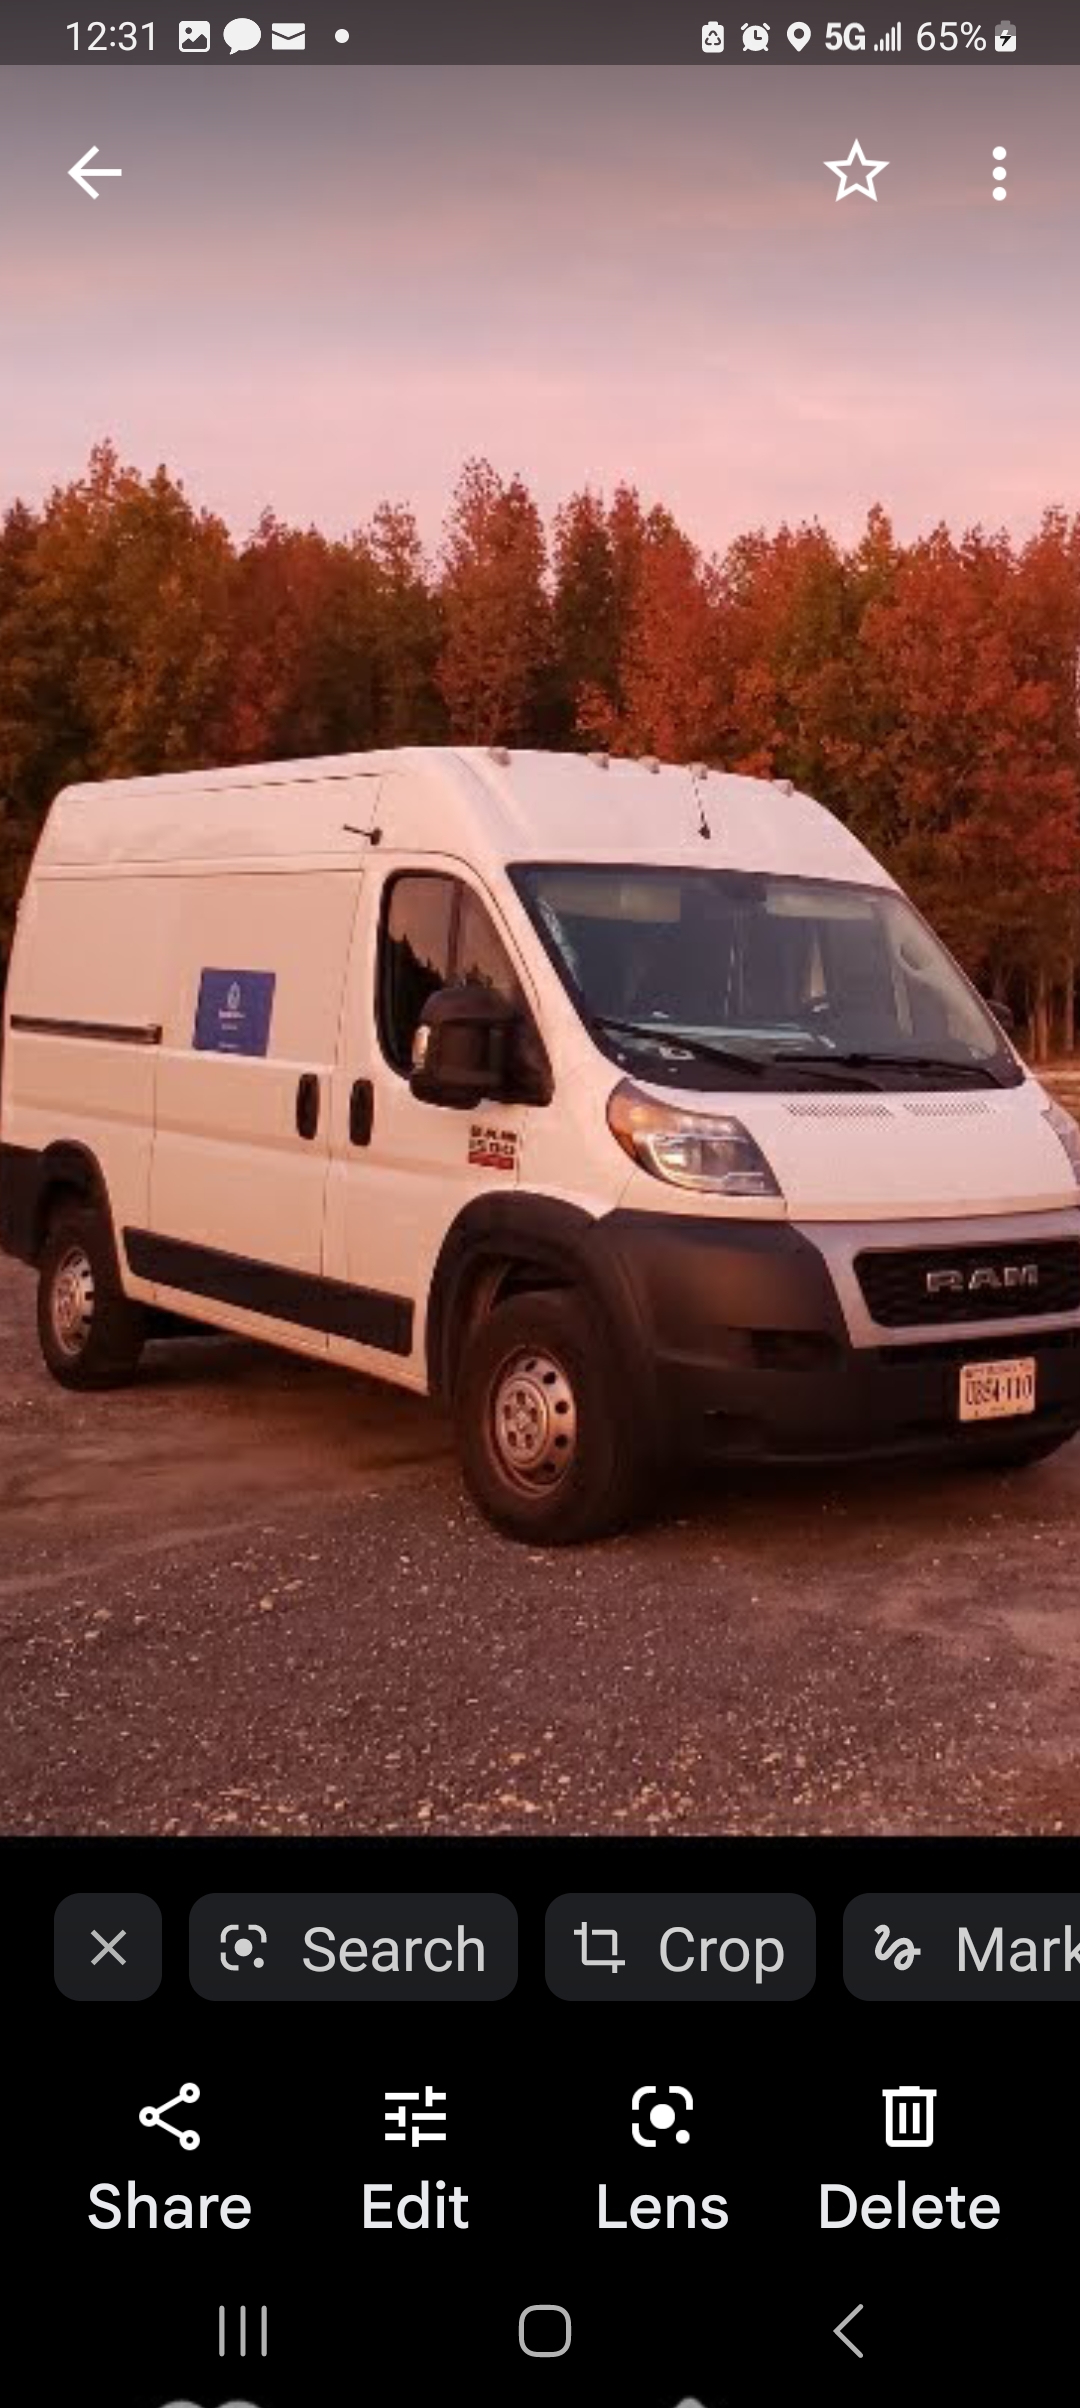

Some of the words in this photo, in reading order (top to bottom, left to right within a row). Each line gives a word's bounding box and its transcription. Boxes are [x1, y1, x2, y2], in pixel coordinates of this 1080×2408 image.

[65, 20, 158, 52] 12:31
[825, 22, 867, 51] 5G
[916, 21, 988, 52] 65%
[926, 1264, 1039, 1293] RAM
[302, 1924, 486, 1973] Search
[659, 1926, 785, 1984] Crop
[957, 1924, 1080, 1973] Mark
[88, 2180, 252, 2230] Share
[363, 2179, 469, 2230] Edit
[597, 2183, 729, 2230] Lens
[820, 2180, 1001, 2230] Delete
